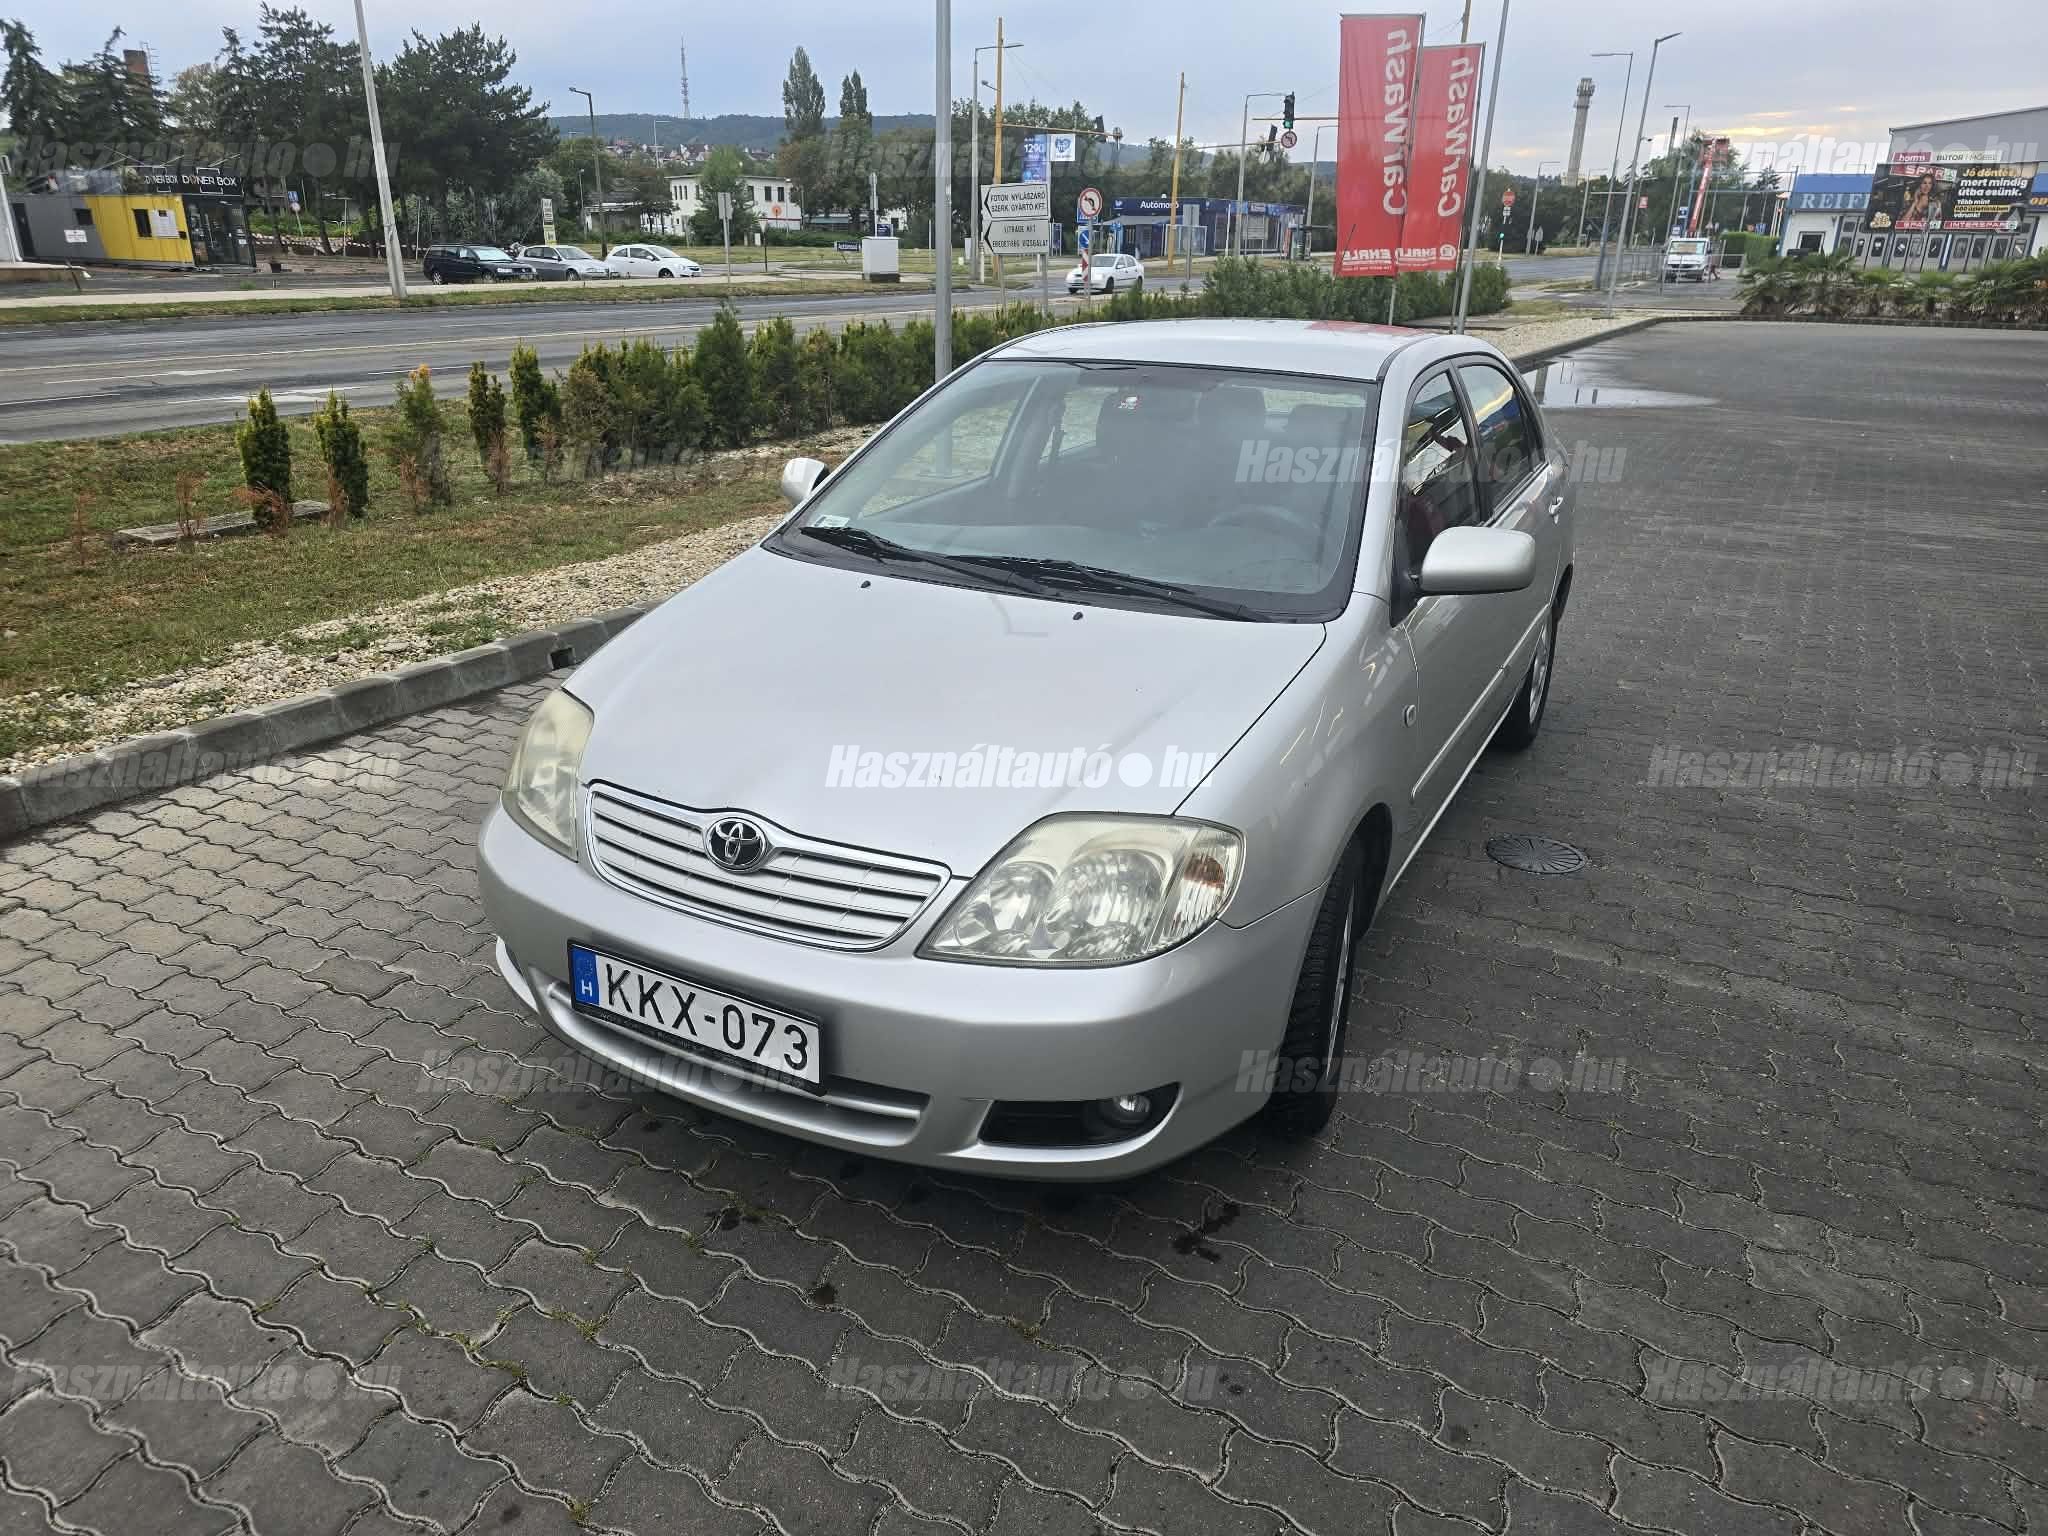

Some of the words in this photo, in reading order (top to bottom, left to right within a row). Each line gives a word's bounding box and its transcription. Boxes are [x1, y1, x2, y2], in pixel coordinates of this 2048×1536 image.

[217, 177, 237, 186] BOX
[1988, 178, 2027, 188] mindig
[1958, 187, 1983, 196] útba
[581, 979, 594, 998] H
[606, 963, 809, 1071] KKX-073
